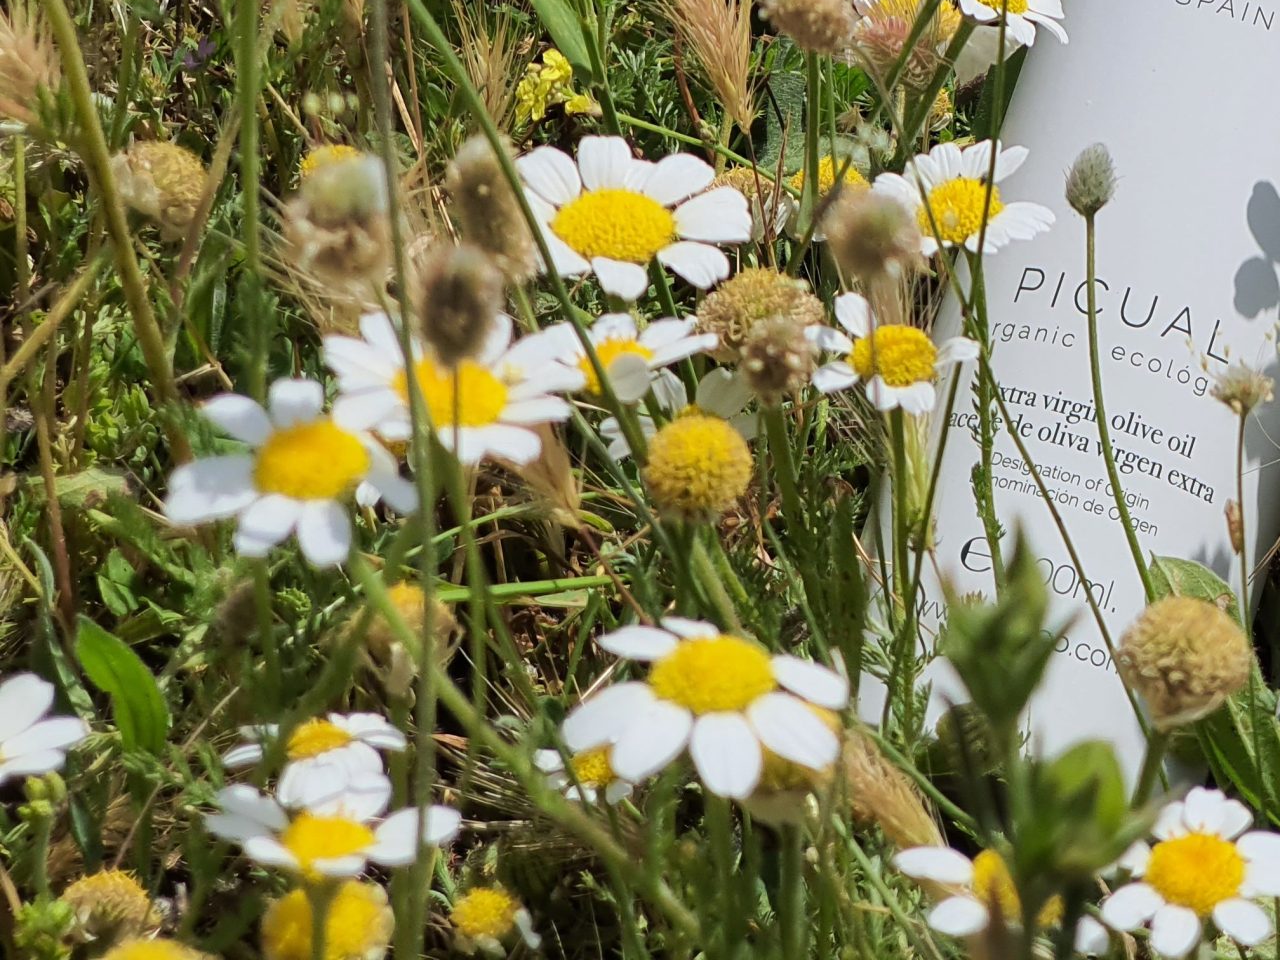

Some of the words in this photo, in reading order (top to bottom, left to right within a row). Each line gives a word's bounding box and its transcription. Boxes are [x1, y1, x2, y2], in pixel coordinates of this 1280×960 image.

[1014, 267, 1229, 364] PICUAL
[991, 320, 1076, 348] rganic
[1111, 345, 1209, 397] ecológ
[949, 412, 1003, 432] acee
[1037, 422, 1089, 453] oliva
[1167, 468, 1215, 504] extra
[999, 386, 1037, 408] xtra
[1111, 411, 1164, 445] olive
[1167, 435, 1197, 459] oil
[969, 475, 1079, 508] nominción
[1083, 498, 1104, 515] de
[1108, 506, 1158, 537] Ogen
[991, 451, 1081, 486] Designation
[1084, 478, 1104, 492] of
[1105, 483, 1150, 511] Oigin
